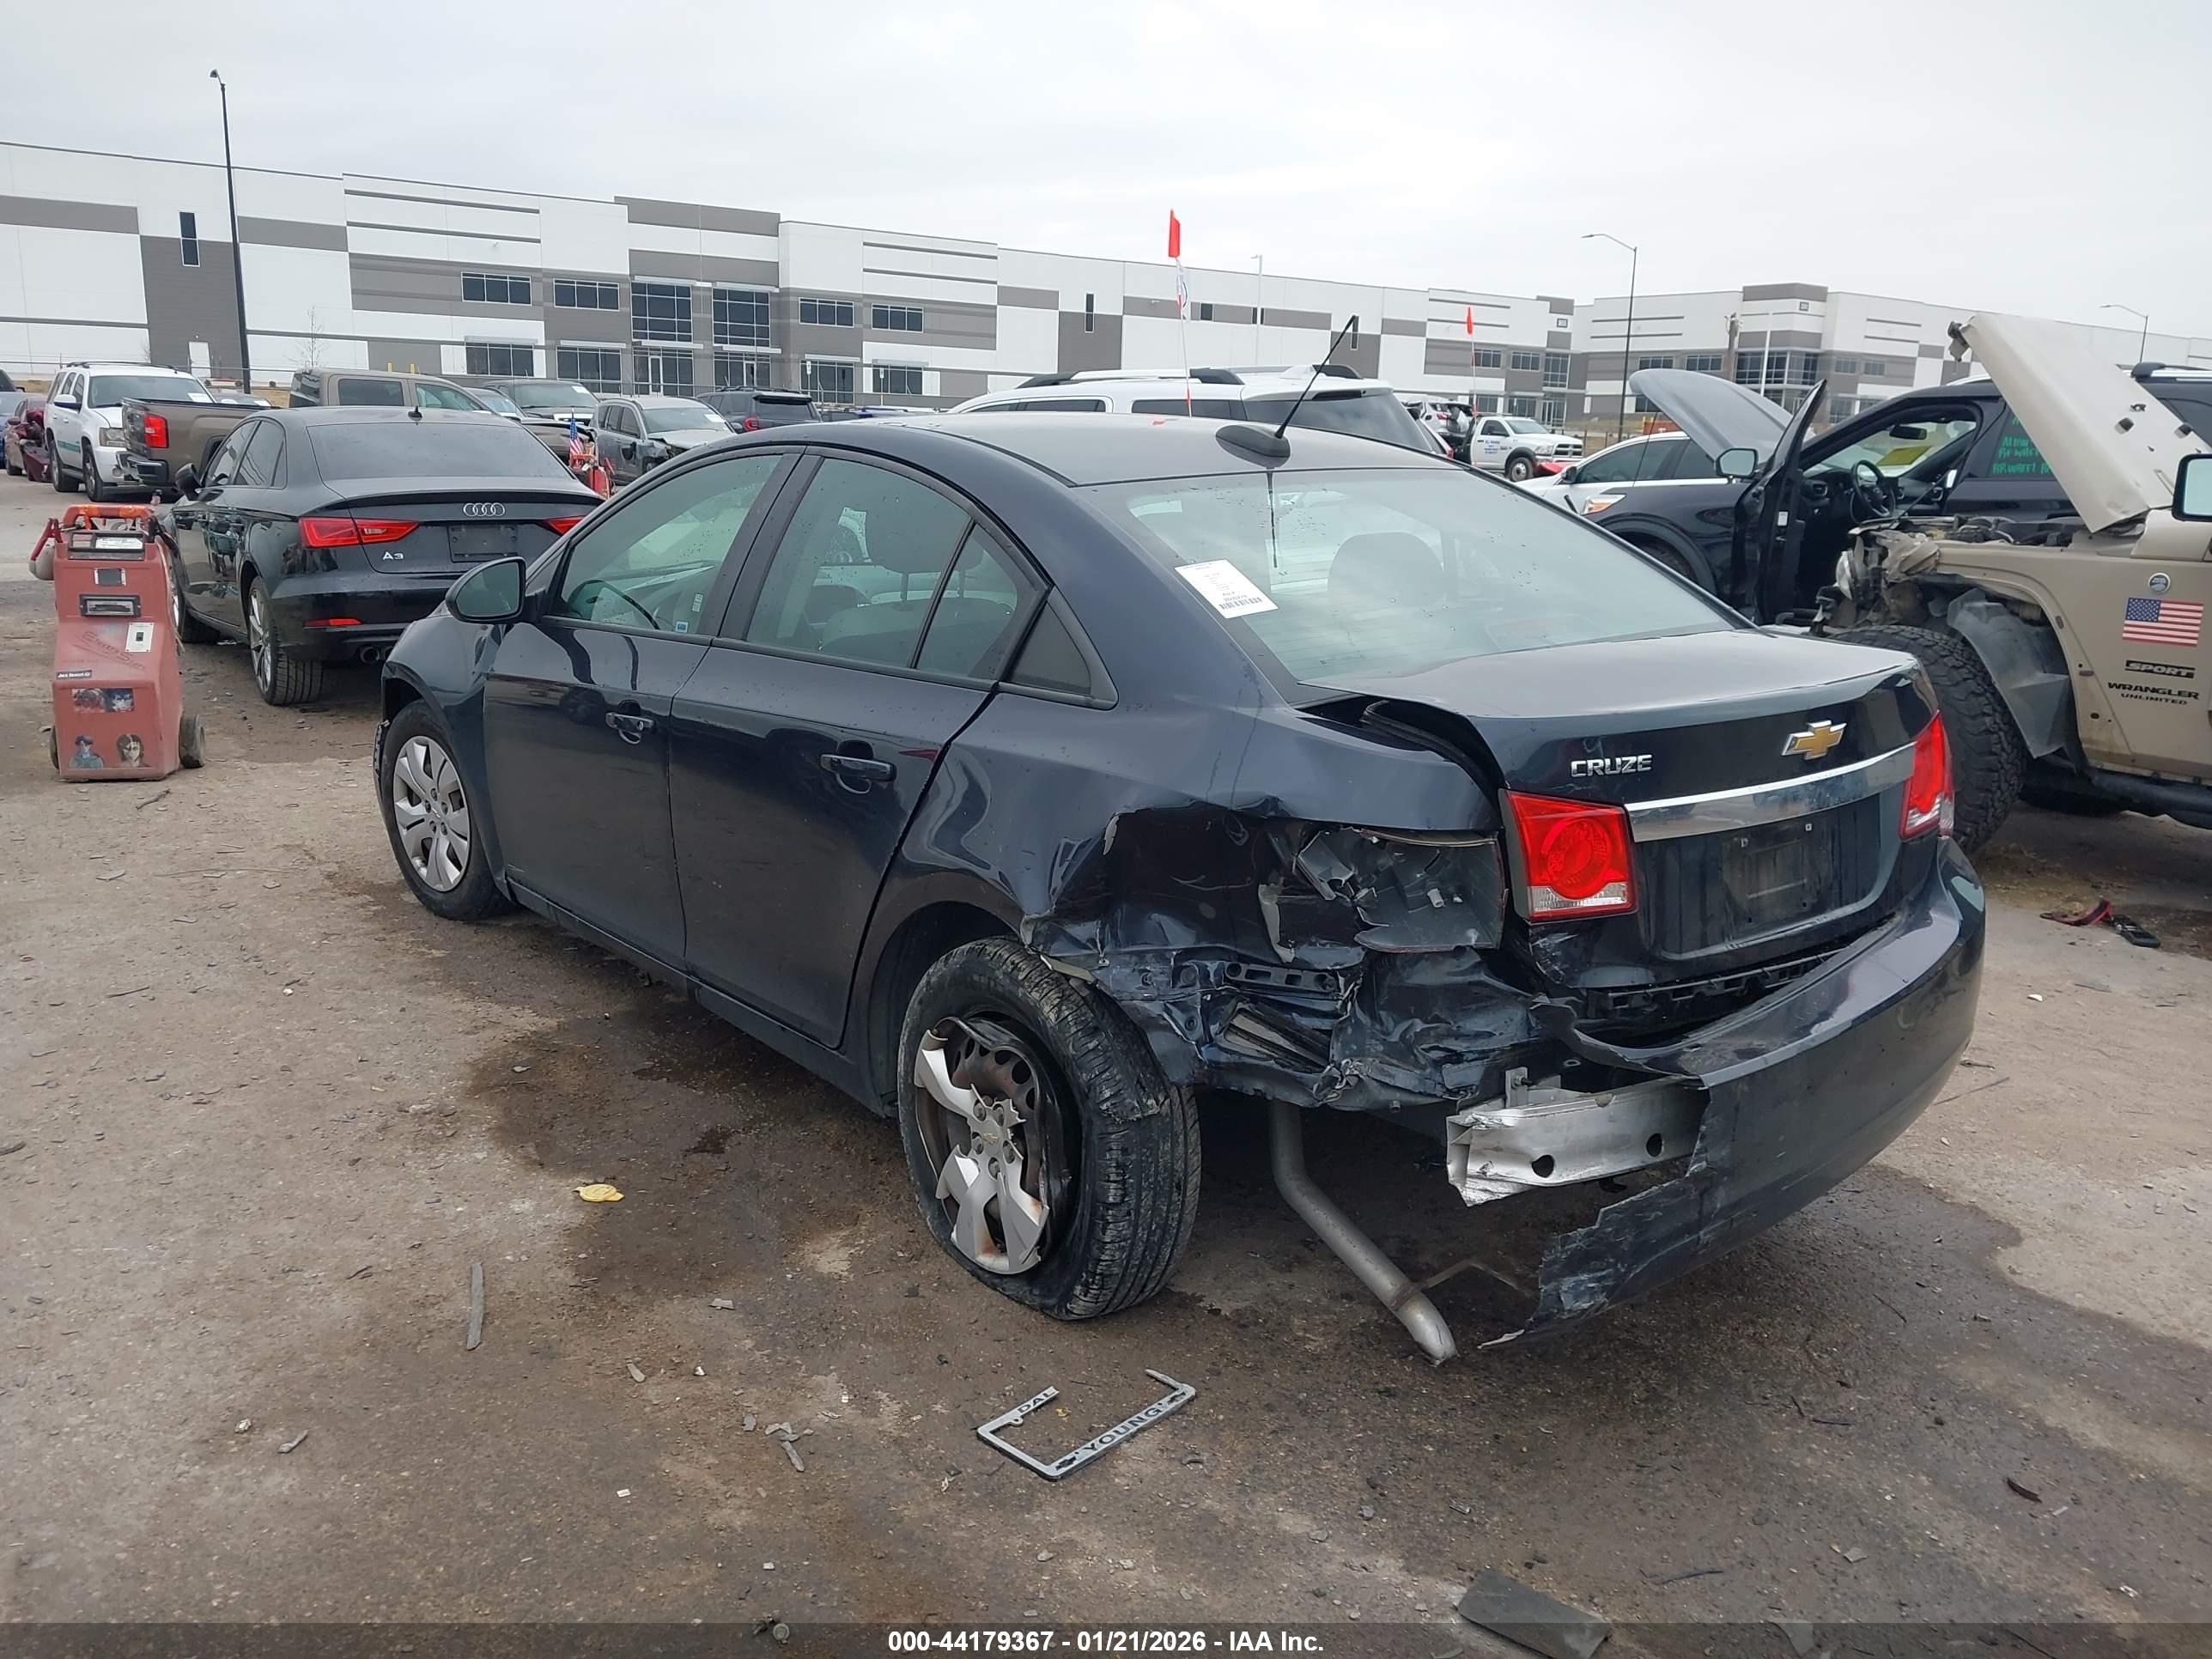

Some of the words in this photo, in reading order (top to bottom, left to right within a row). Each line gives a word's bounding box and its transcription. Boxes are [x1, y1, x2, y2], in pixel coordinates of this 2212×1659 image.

[382, 550, 404, 561] A3
[2125, 660, 2196, 678] SPORT
[2107, 682, 2200, 700] WRANGLER
[2120, 692, 2188, 706] UNLIMITED
[1570, 753, 1653, 778] CRUZE
